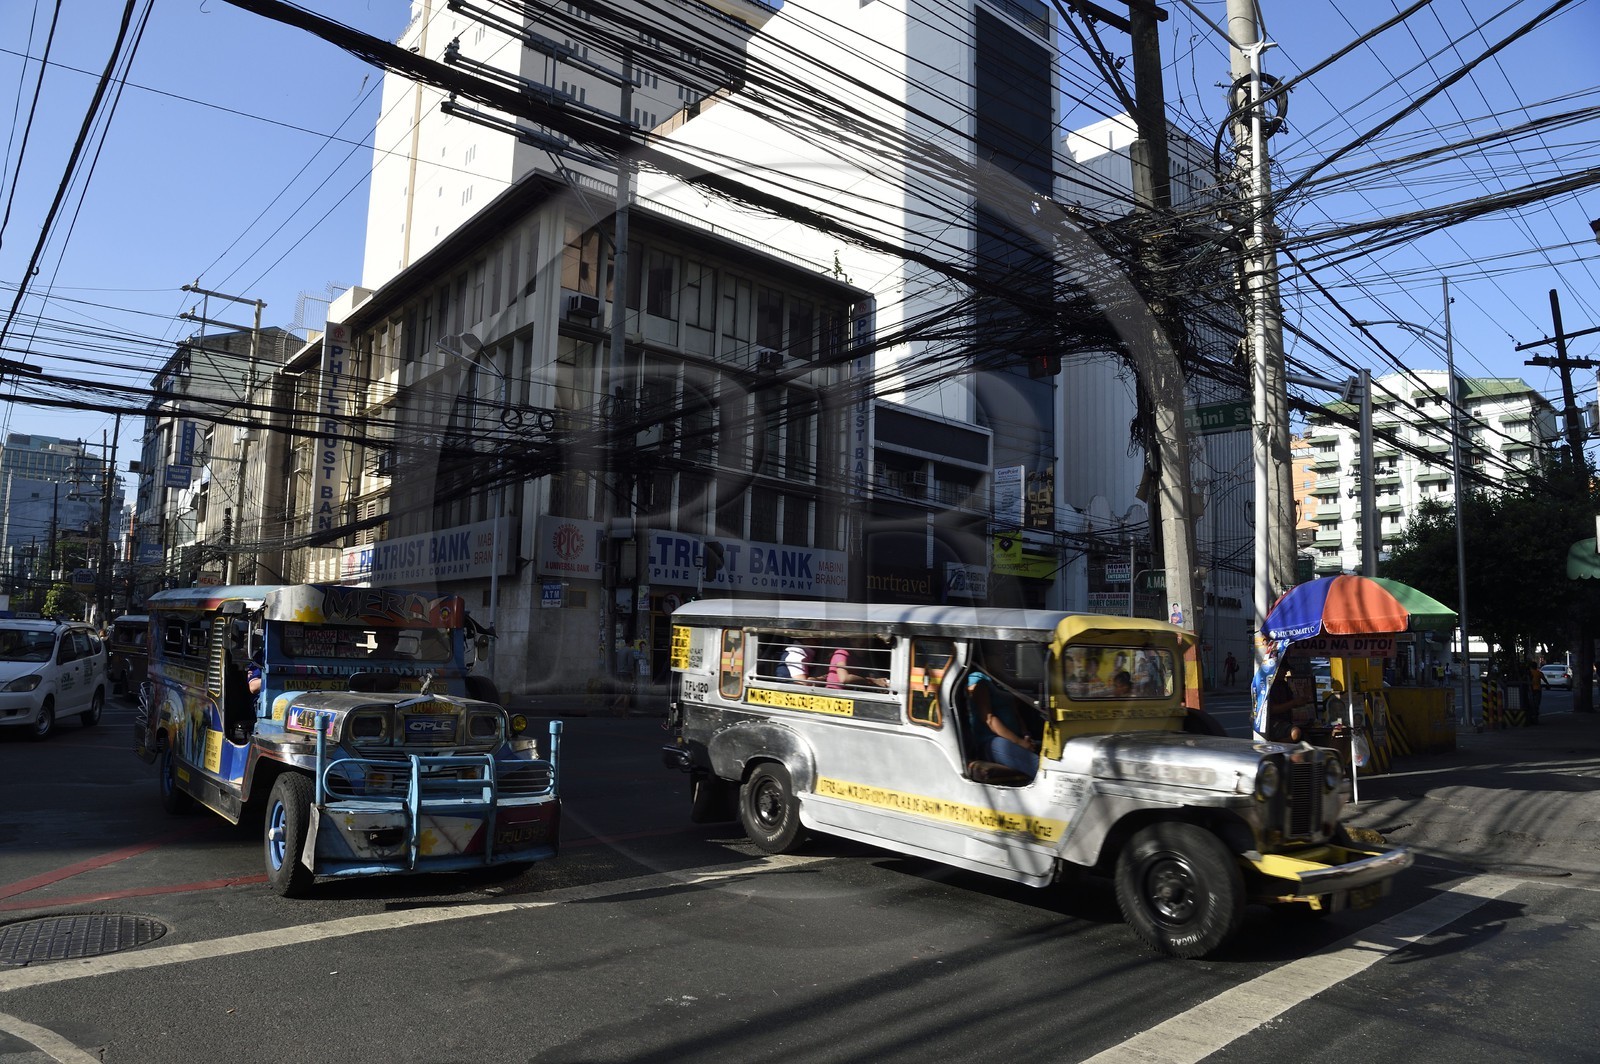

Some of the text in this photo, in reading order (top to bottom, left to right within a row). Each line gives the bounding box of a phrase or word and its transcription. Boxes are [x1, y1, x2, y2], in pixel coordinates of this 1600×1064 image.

[1184, 410, 1225, 428] abini
[359, 531, 471, 573] PHILTRUST BANK
[474, 549, 503, 565] BRANH
[749, 547, 813, 579] BANK
[818, 561, 844, 573] MABINI
[401, 568, 425, 579] TRUST
[429, 563, 471, 576] COMPANY
[751, 576, 813, 590] COMPANY
[815, 573, 847, 586] BRANCH
[543, 590, 561, 599] ATM
[1088, 599, 1105, 607] MONEY
[1294, 638, 1393, 650] LOAD NA DITO!
